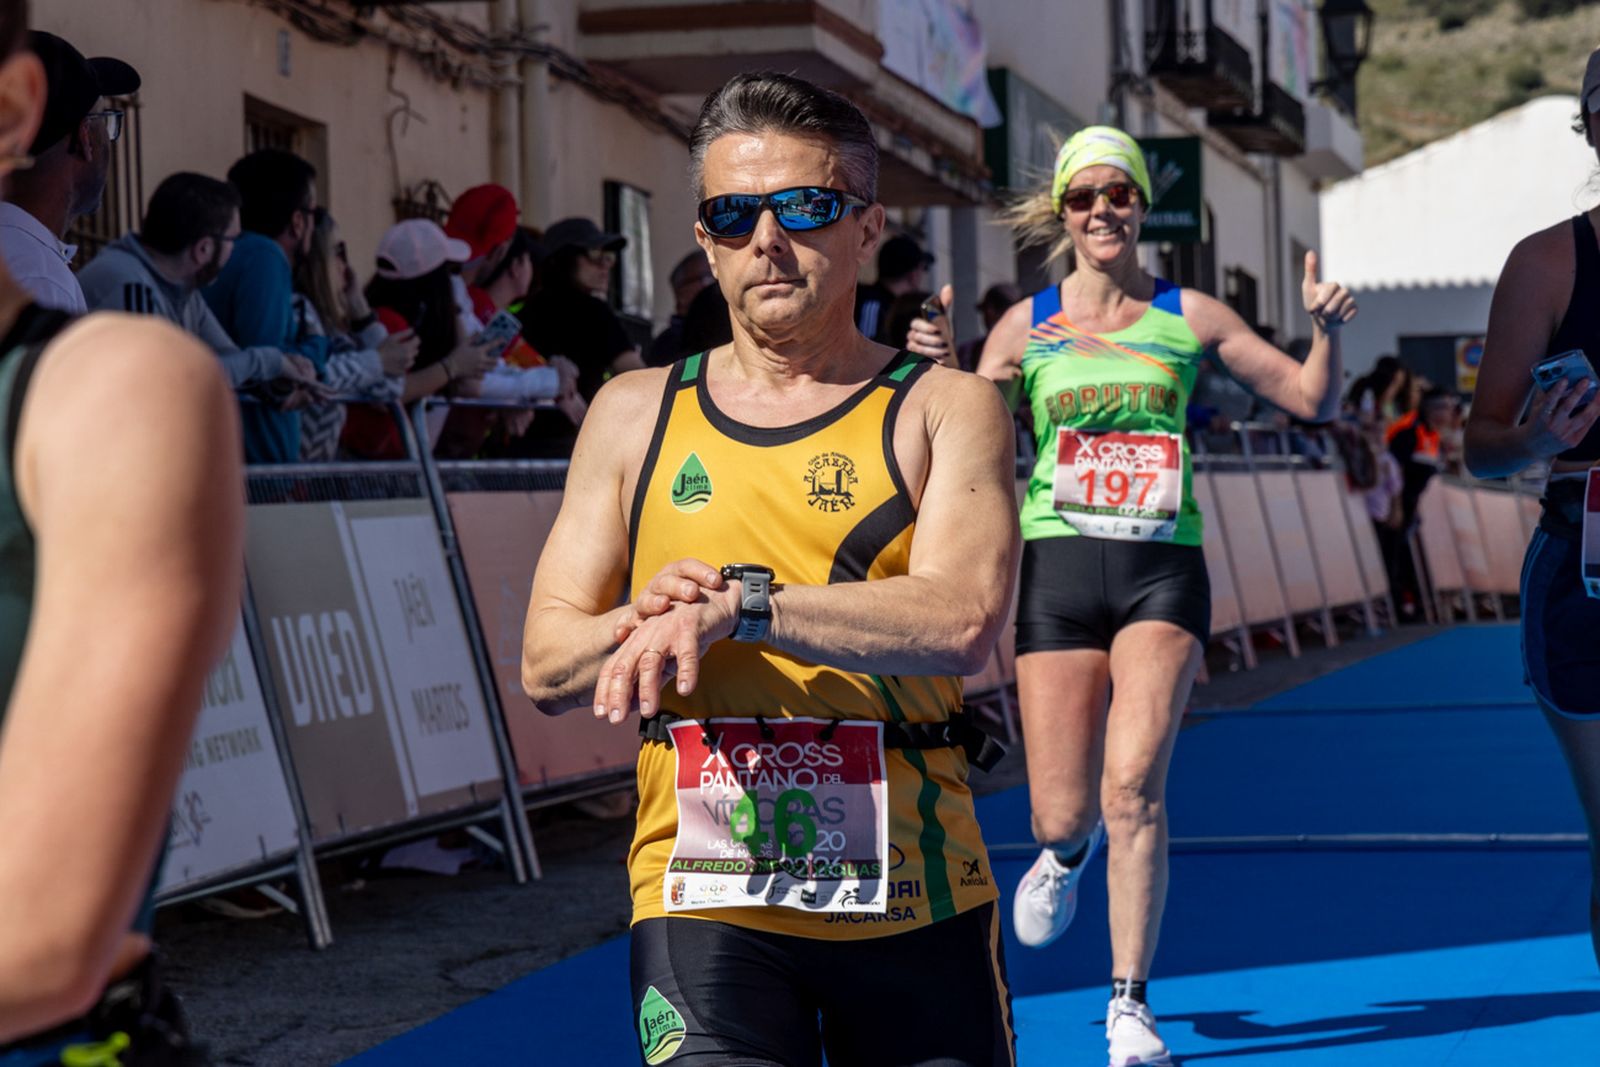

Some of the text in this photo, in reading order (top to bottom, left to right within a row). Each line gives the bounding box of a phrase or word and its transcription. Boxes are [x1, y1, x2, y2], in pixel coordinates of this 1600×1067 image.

[1075, 435, 1166, 462] X CROSS
[672, 472, 710, 497] Jaén
[1077, 468, 1159, 508] 197
[271, 609, 374, 728] UNED
[205, 725, 263, 766] NETWORK
[701, 731, 729, 769] X
[730, 741, 844, 768] CROSS
[700, 766, 844, 796] PANTANO DEL
[730, 787, 817, 857] 46
[670, 858, 747, 873] ALFREDO
[642, 1009, 677, 1049] Jaén
